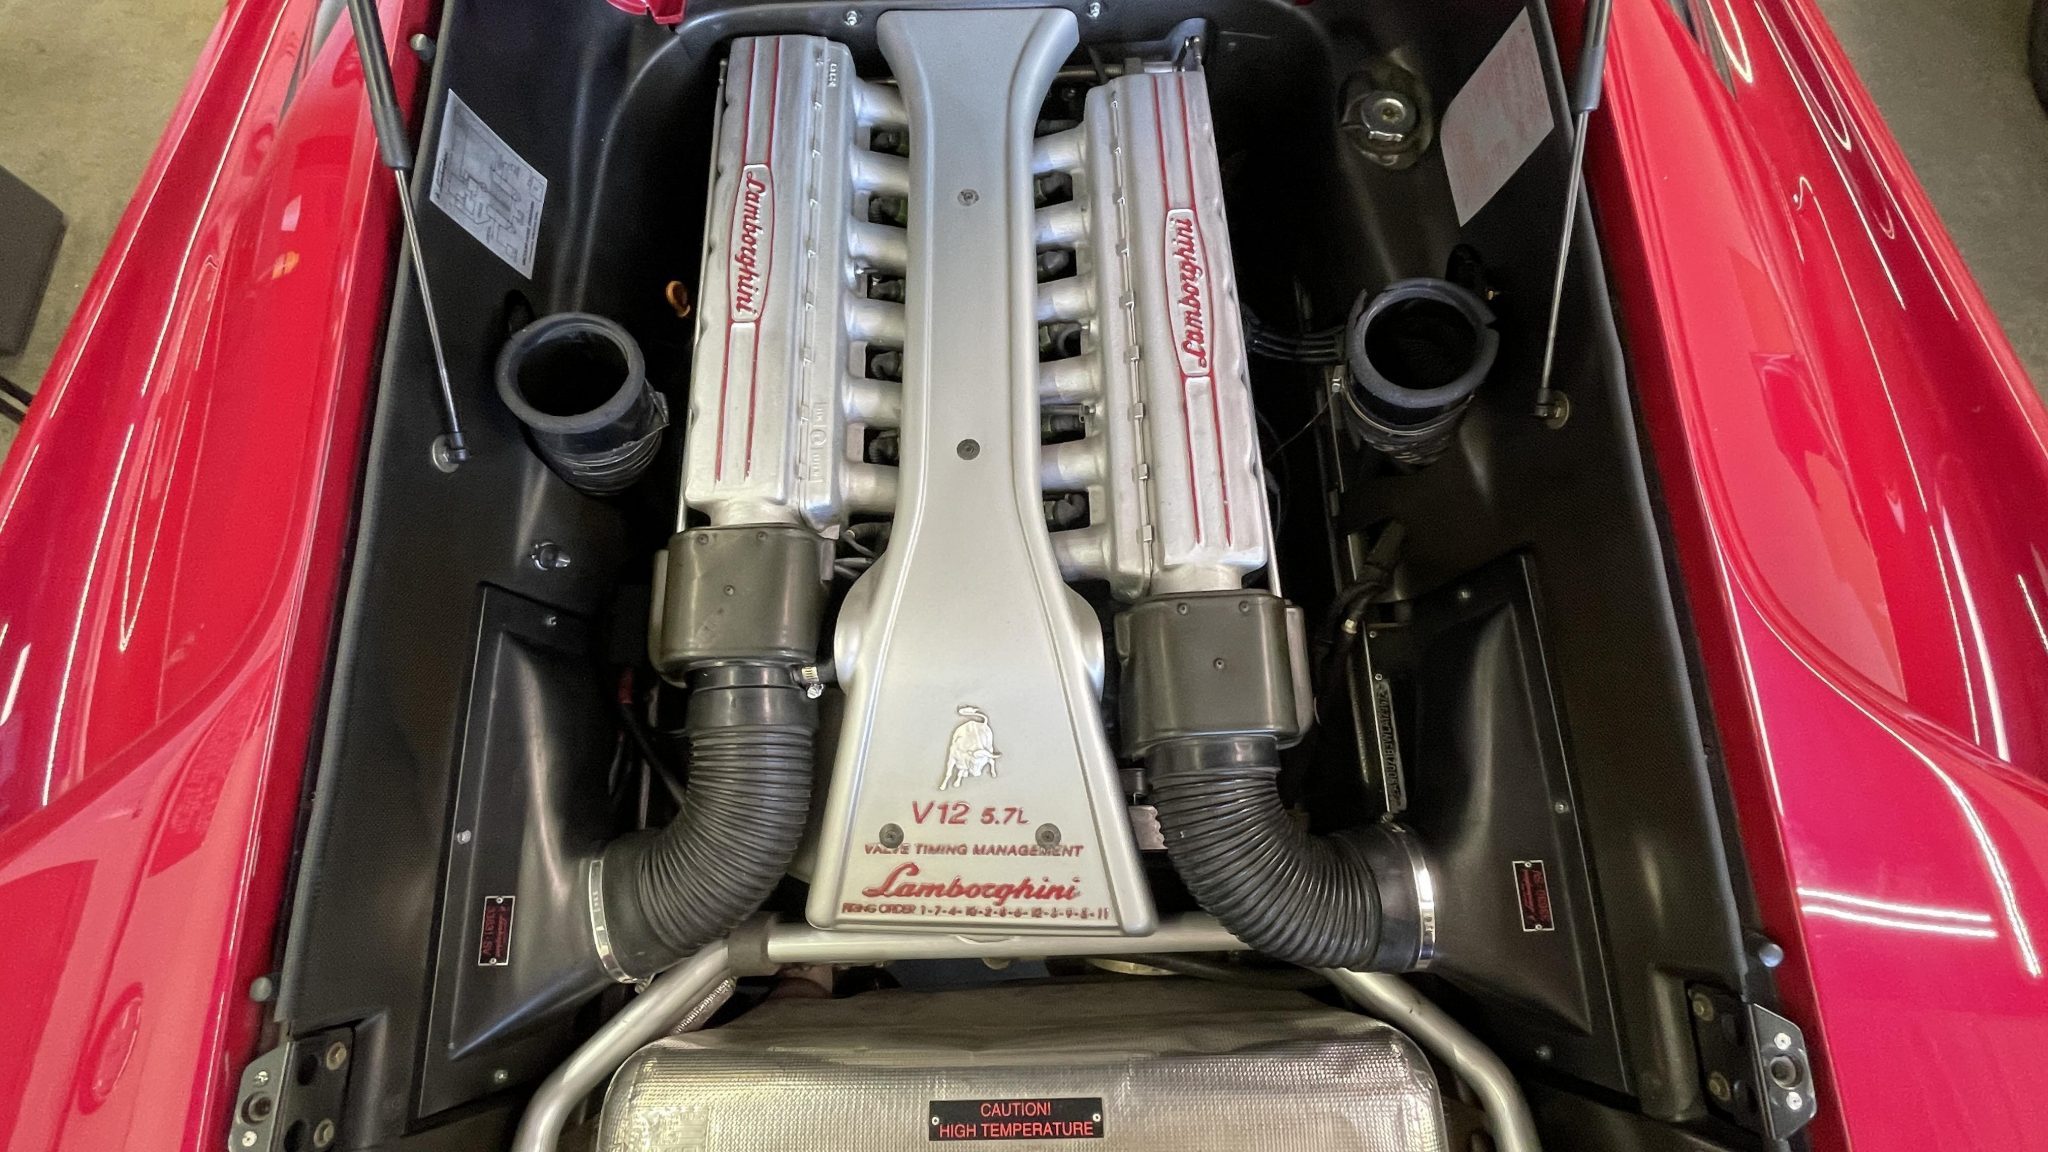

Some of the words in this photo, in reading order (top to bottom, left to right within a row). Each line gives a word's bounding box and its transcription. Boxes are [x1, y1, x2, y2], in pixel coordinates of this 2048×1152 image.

[734, 170, 766, 315] Lamborghini
[1170, 216, 1208, 368] Lamborghini
[911, 800, 971, 825] V12
[980, 807, 1030, 825] 5.7L
[914, 843, 968, 856] TIMING
[972, 844, 1085, 858] MANAGEMENT
[861, 861, 1082, 907] Lamborghini
[980, 1101, 1051, 1117] CAUTION!
[939, 1124, 977, 1138] HIGH
[981, 1121, 1094, 1138] TEMPERATURE
